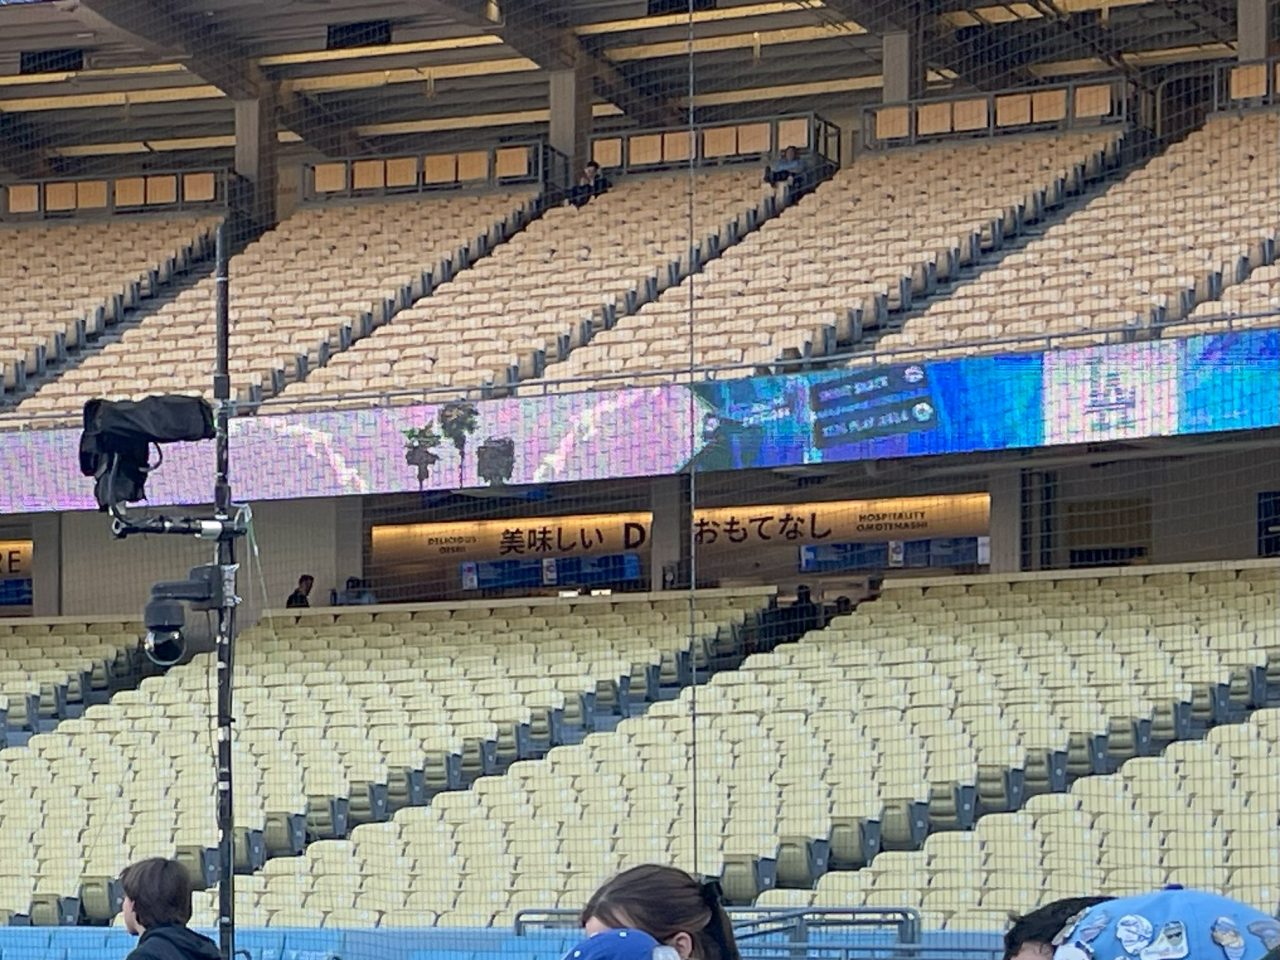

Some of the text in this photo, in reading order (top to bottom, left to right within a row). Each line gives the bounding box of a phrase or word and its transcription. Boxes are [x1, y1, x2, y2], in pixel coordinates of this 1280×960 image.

[693, 512, 832, 545] おもてなし
[858, 511, 926, 523] HOSPITALITY
[499, 526, 604, 555] 美味しい
[624, 522, 646, 549] D
